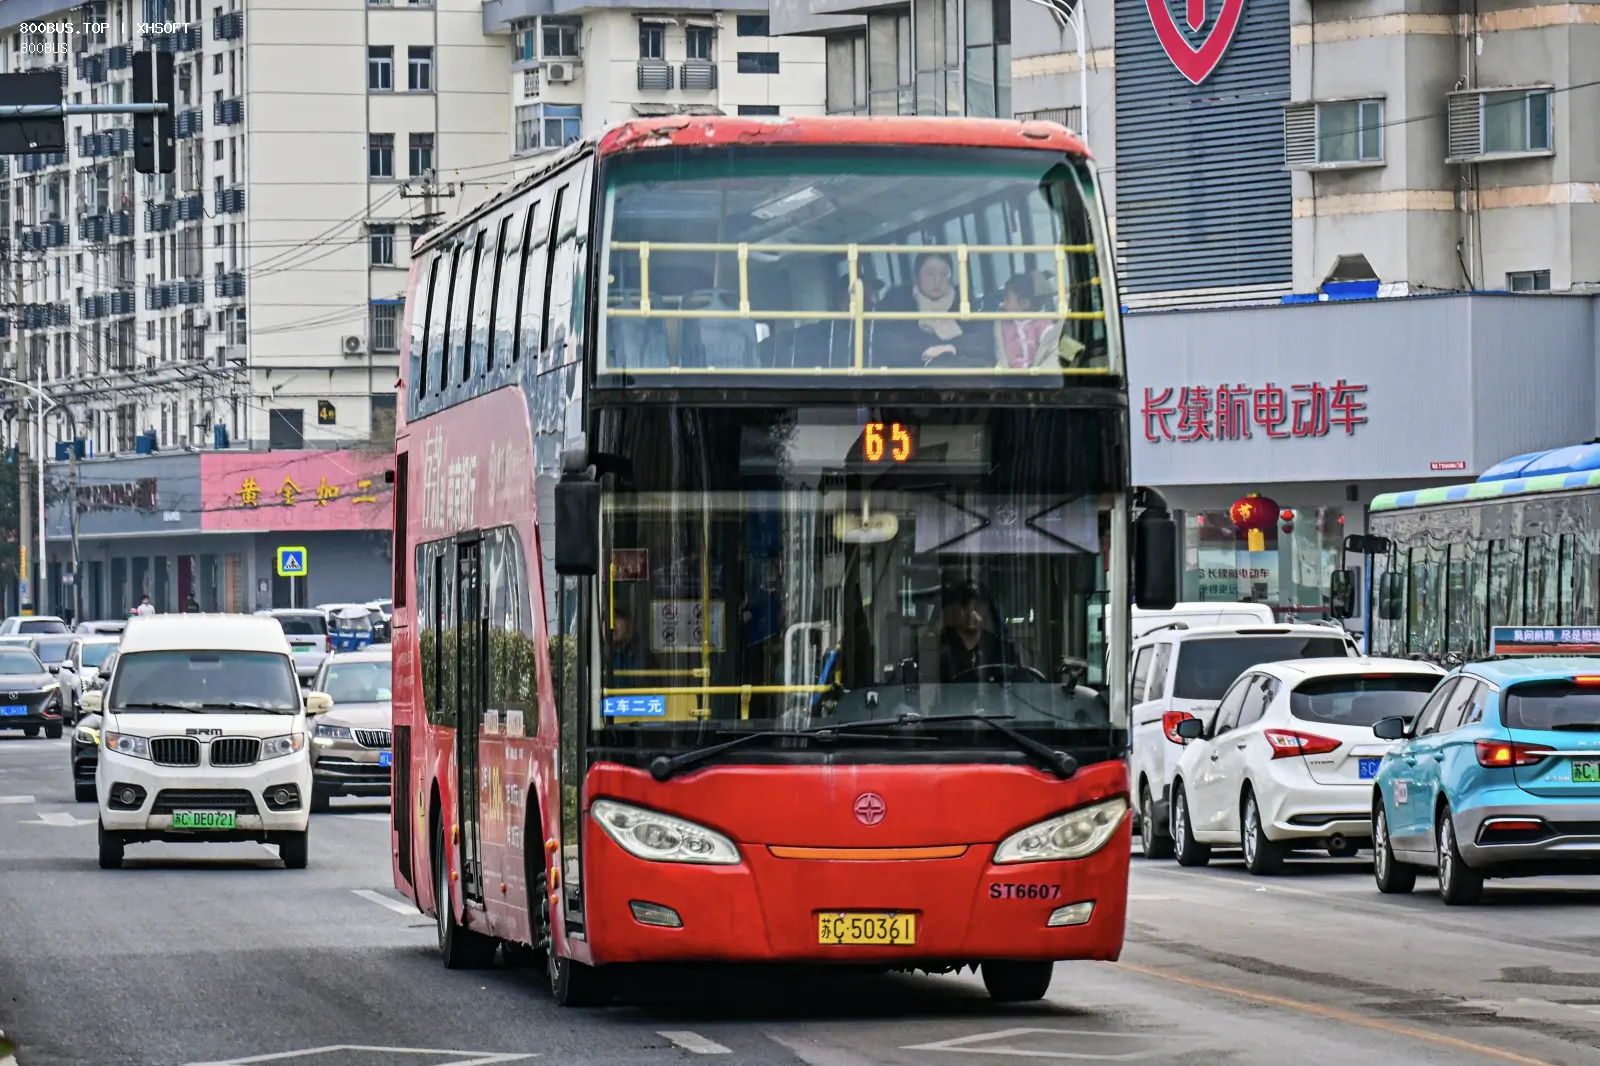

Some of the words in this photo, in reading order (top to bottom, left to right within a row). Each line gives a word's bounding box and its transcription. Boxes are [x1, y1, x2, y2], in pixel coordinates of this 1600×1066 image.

[1140, 379, 1367, 442] 长续航电动车
[865, 422, 910, 462] 65
[603, 698, 663, 714] 上车二元
[185, 728, 223, 736] SRM
[1573, 763, 1600, 779] 苏C
[989, 883, 1061, 900] ST6607
